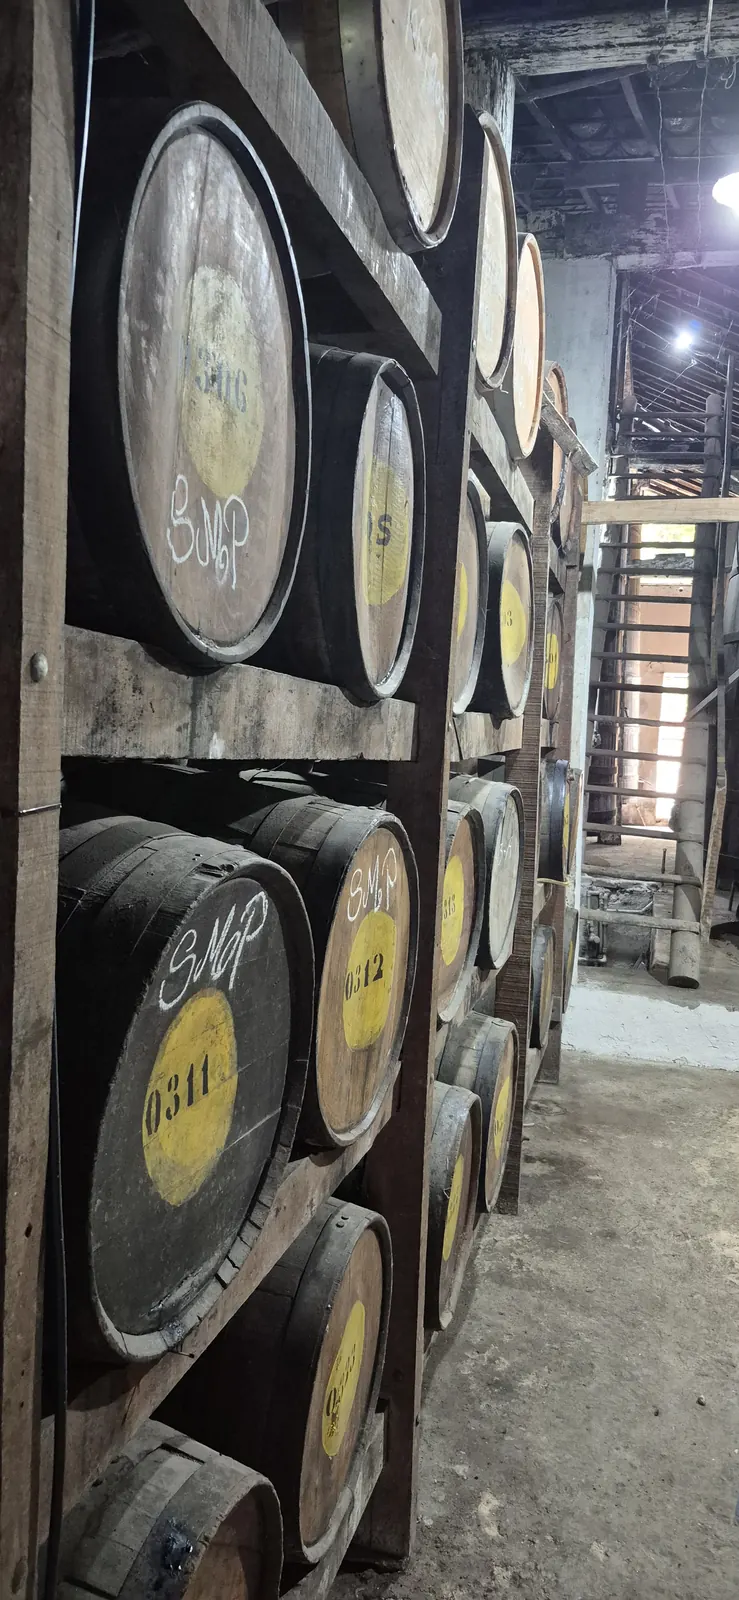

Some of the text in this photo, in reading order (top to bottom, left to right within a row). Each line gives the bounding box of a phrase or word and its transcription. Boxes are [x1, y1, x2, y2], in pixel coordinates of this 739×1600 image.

[442, 893, 456, 919] 313
[345, 953, 385, 1001] 0312
[145, 1053, 210, 1137] 0311
